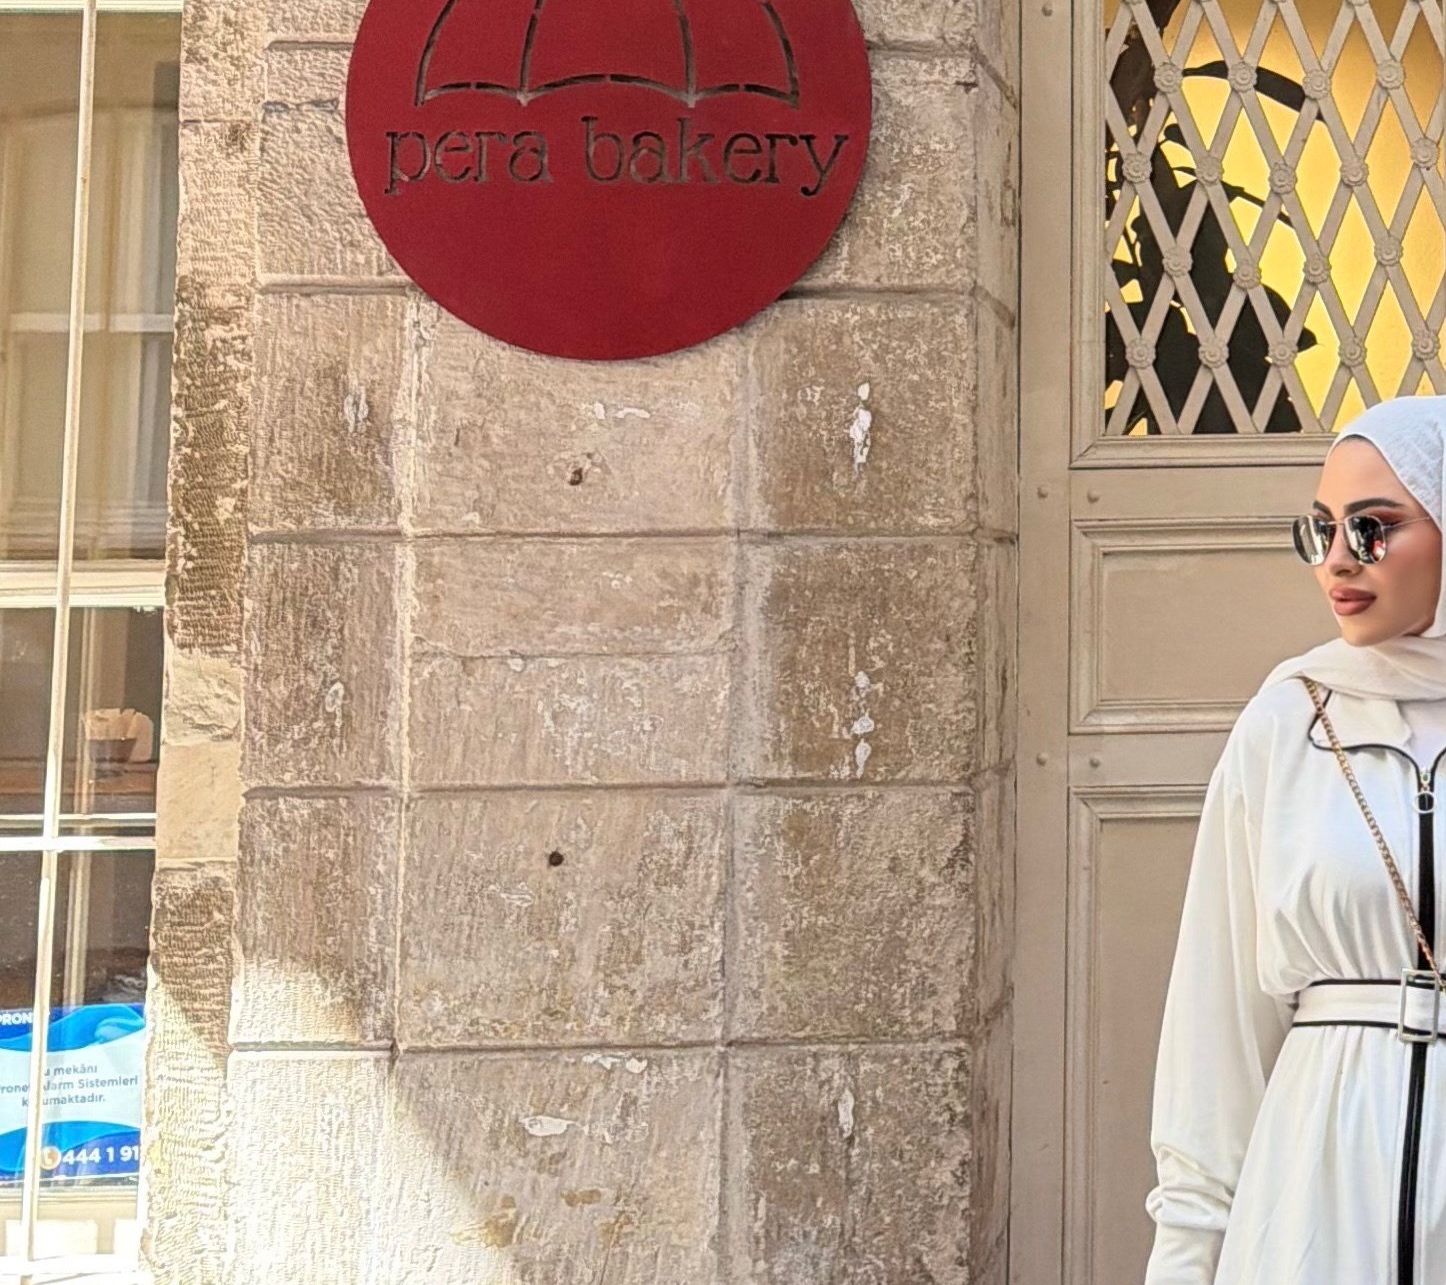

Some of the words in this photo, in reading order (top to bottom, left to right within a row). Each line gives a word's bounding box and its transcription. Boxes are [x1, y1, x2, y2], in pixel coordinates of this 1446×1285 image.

[384, 128, 554, 195] pera
[581, 116, 850, 197] bakery
[78, 1075, 138, 1089] Sistemleri
[62, 1149, 101, 1165] 444
[106, 1146, 115, 1163] 1
